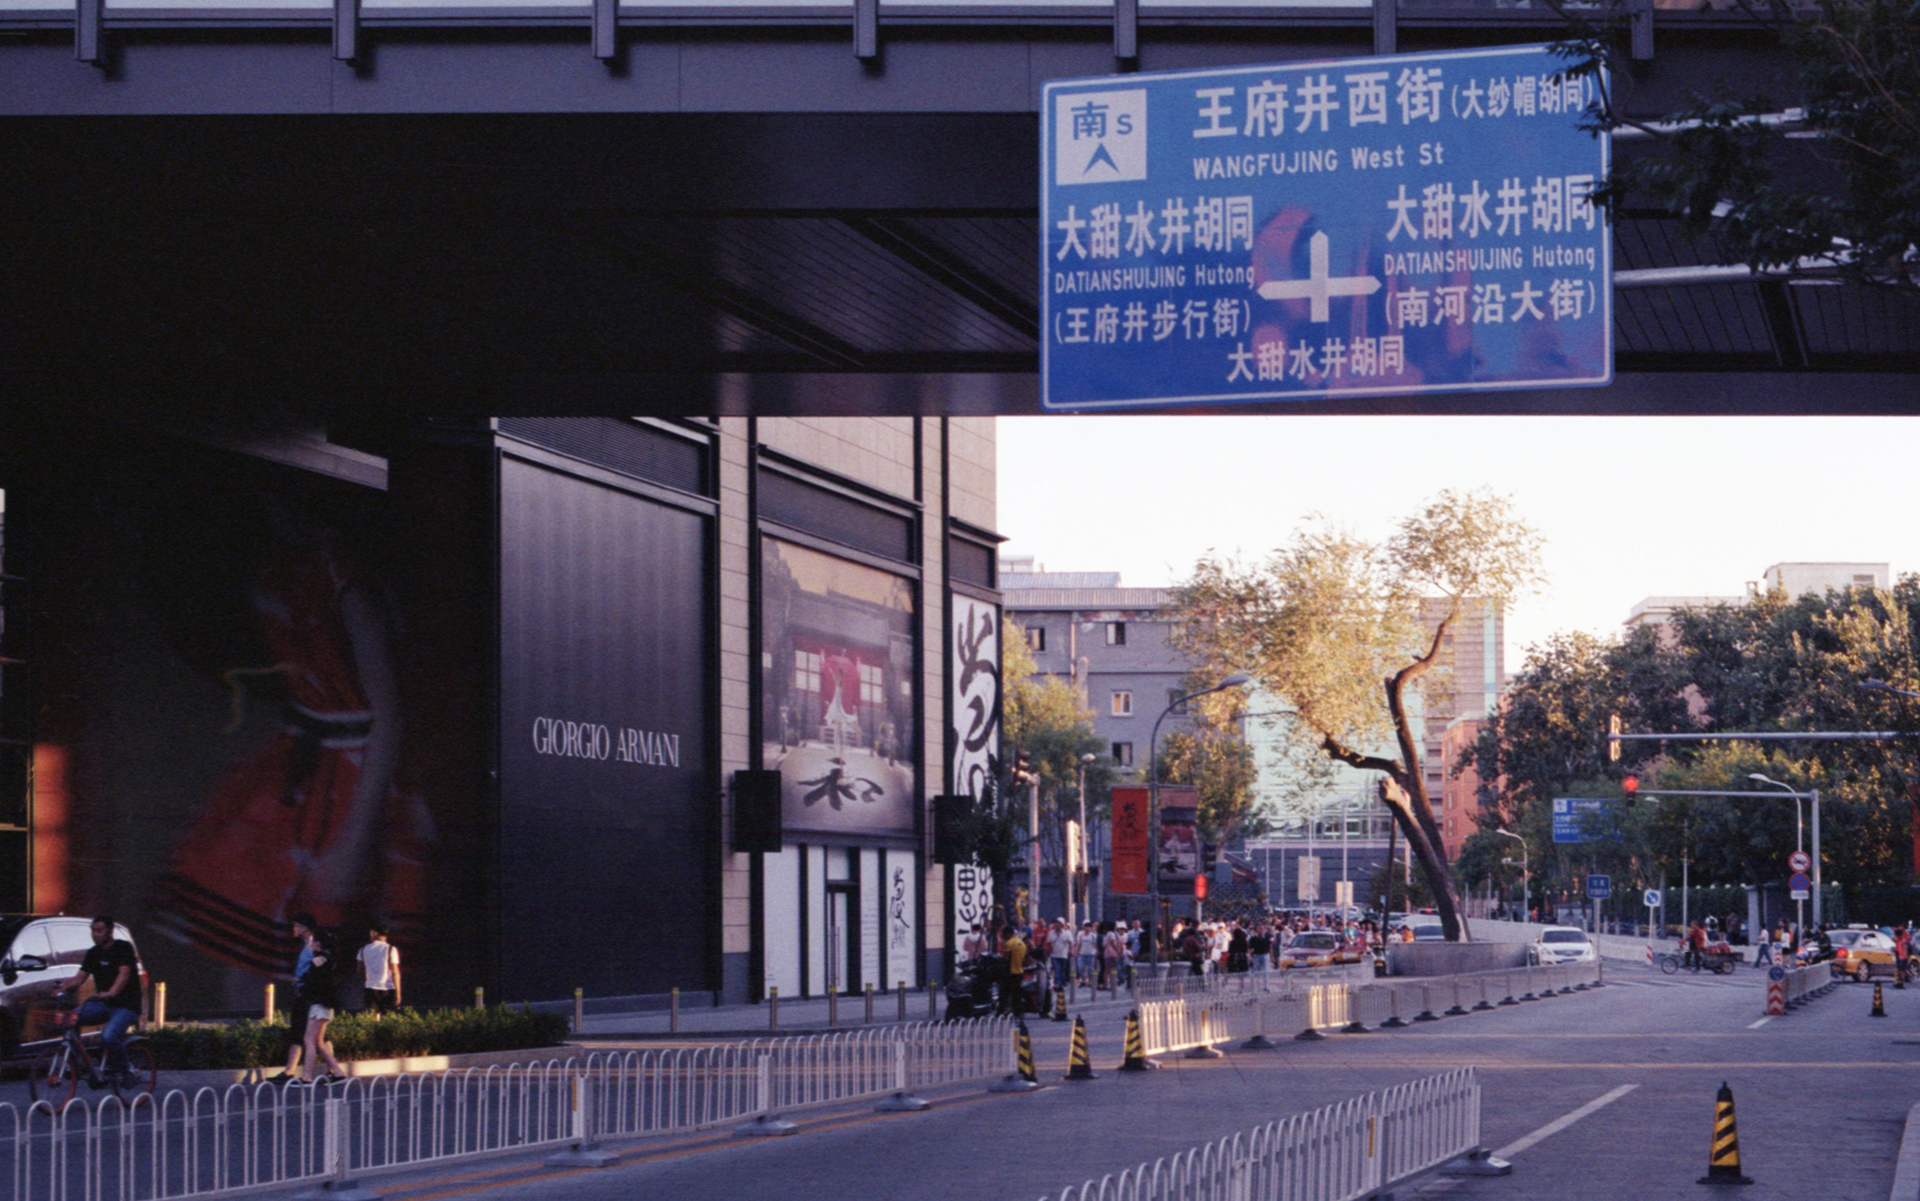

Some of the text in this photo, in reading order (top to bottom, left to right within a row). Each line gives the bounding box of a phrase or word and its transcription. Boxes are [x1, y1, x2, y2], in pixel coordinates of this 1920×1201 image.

[1071, 101, 1133, 141] 南 S
[1192, 67, 1444, 139] 王府井西街
[1192, 143, 1444, 180] WANGFUJING West St
[1056, 195, 1255, 262] 大甜水井胡同
[1386, 174, 1595, 242] 大甜水井胡同
[1055, 262, 1256, 295] DATIANSHUIJING Hutong
[1384, 244, 1596, 276] DATIANSHUIJING Hutong
[1055, 299, 1251, 345] (王府井步行街)
[1385, 278, 1596, 328] (南河沿大街)
[1226, 335, 1405, 384] 大甜水井胡同
[532, 716, 680, 768] GIORGIO ARMANI
